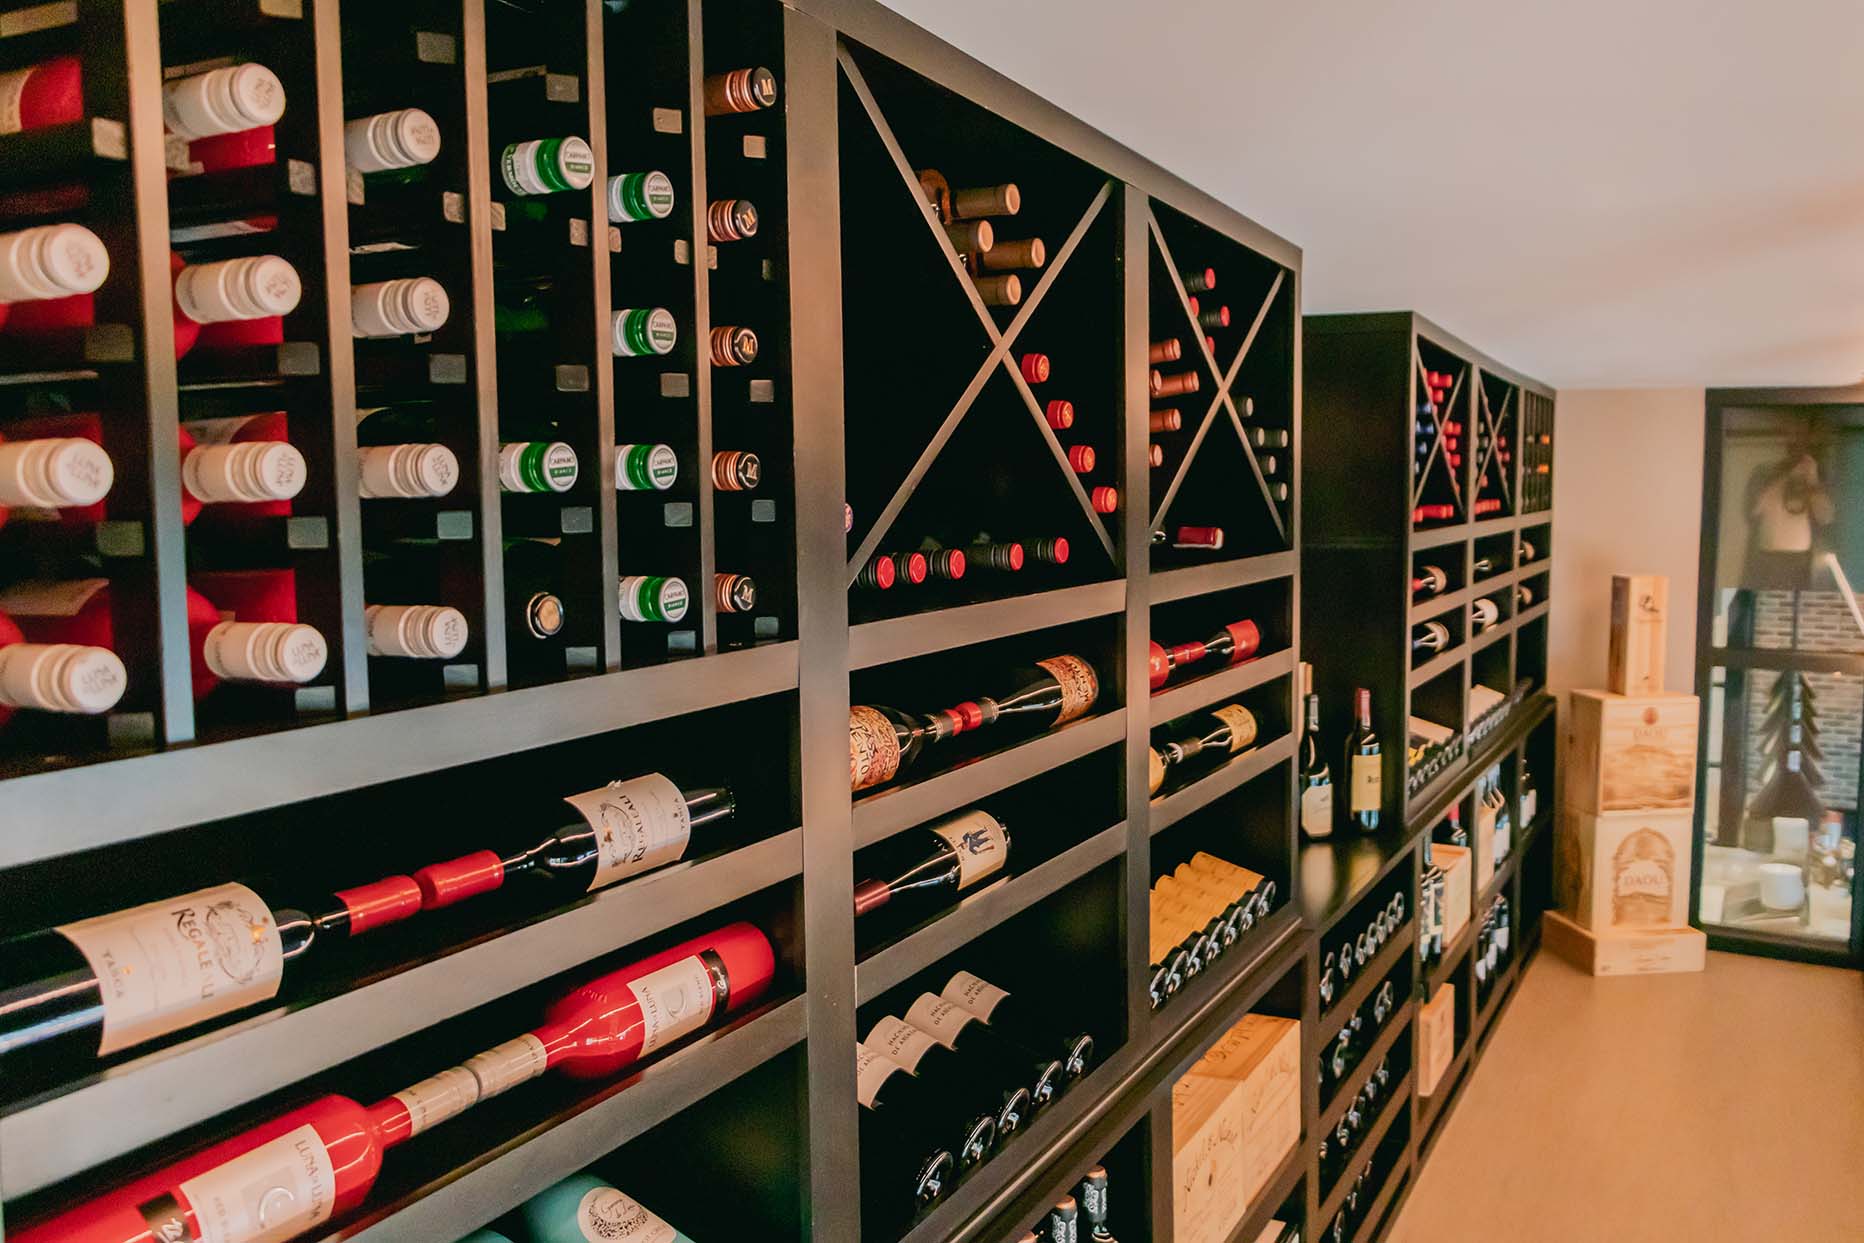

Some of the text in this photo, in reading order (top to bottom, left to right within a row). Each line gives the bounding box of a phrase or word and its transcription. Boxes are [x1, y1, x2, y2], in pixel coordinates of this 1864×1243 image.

[761, 78, 774, 96] M
[742, 209, 757, 229] M
[742, 336, 754, 354] M
[745, 462, 758, 480] M
[740, 585, 754, 602] M
[850, 730, 870, 775] ENTO
